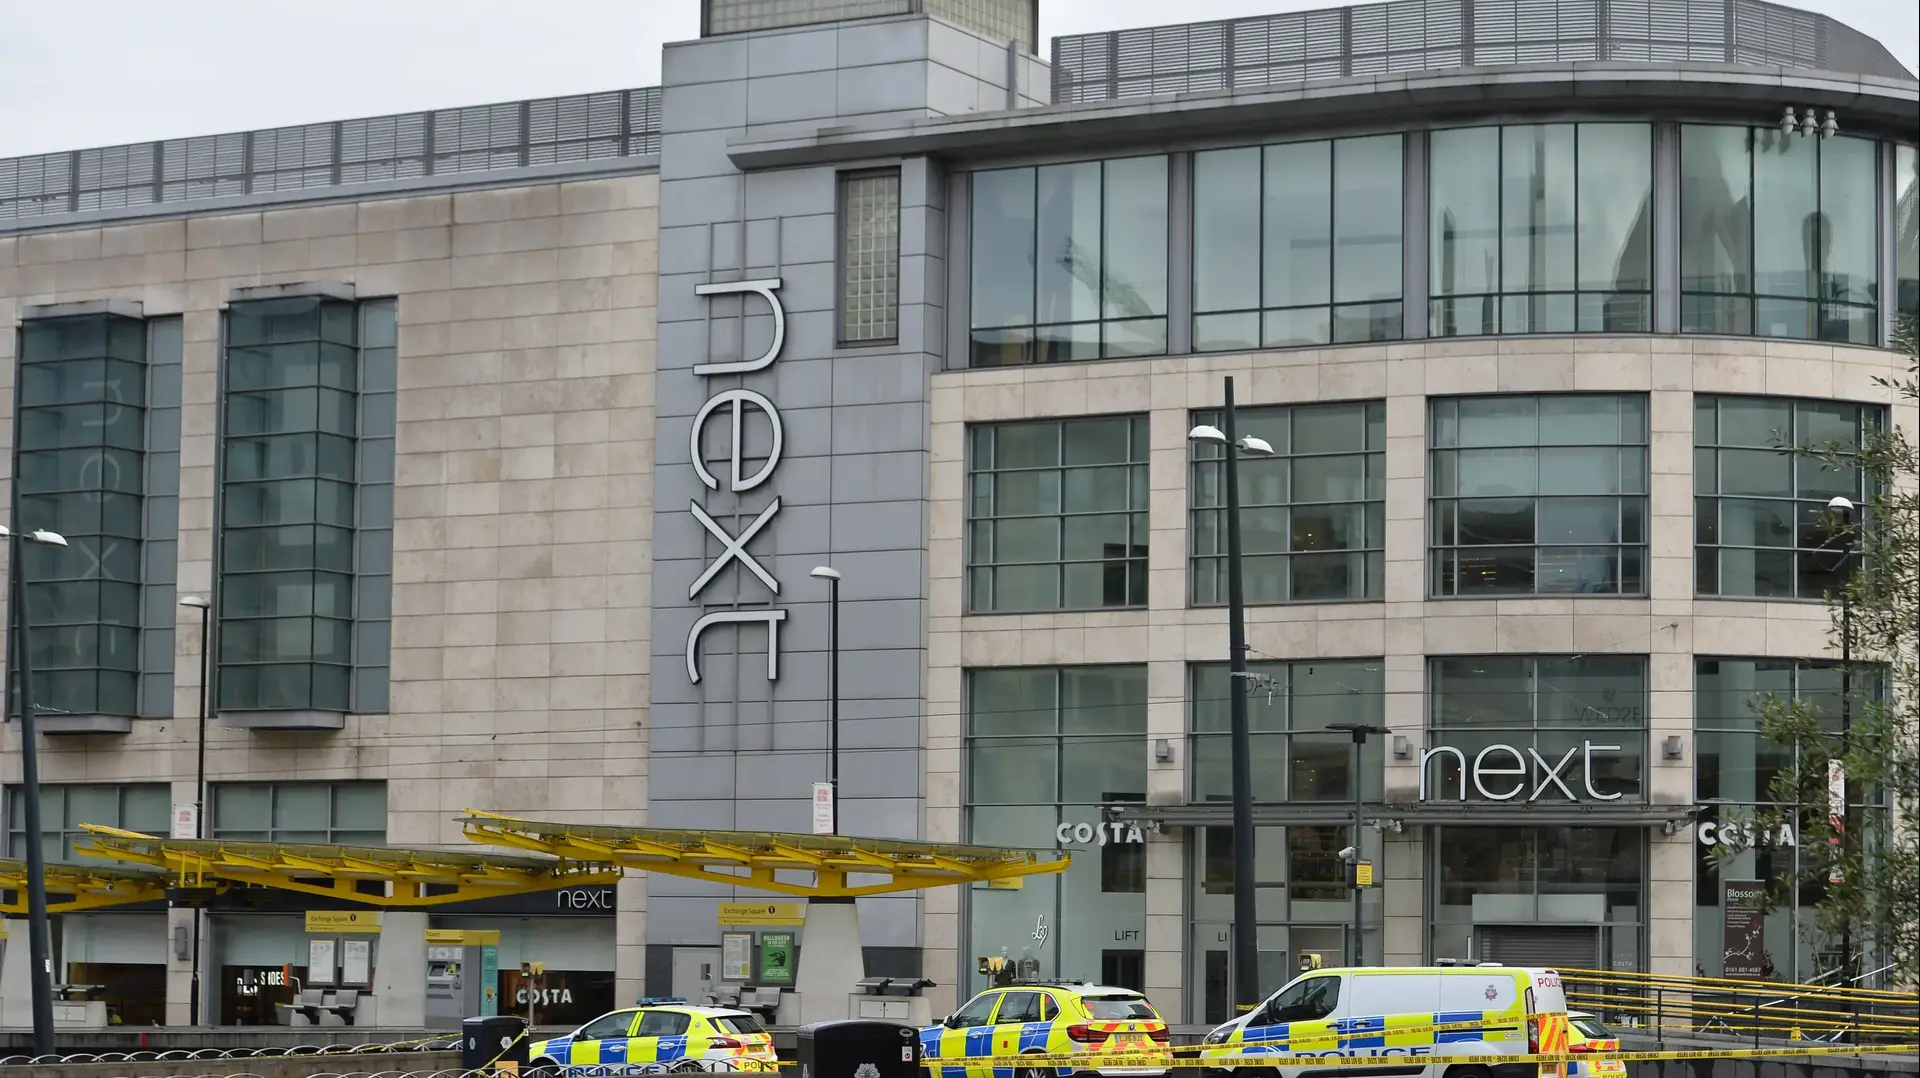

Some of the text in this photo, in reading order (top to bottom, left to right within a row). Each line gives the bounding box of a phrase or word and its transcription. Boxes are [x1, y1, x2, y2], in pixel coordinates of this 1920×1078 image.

[686, 277, 788, 685] next
[1419, 740, 1622, 801] next
[1056, 821, 1144, 846] COSTA
[557, 889, 612, 909] next
[724, 907, 747, 915] Exchange
[748, 907, 766, 916] Square
[1115, 930, 1139, 941] LIFT
[1218, 932, 1228, 942] LI
[1538, 977, 1562, 988] POLIC
[516, 988, 572, 1006] COSTA
